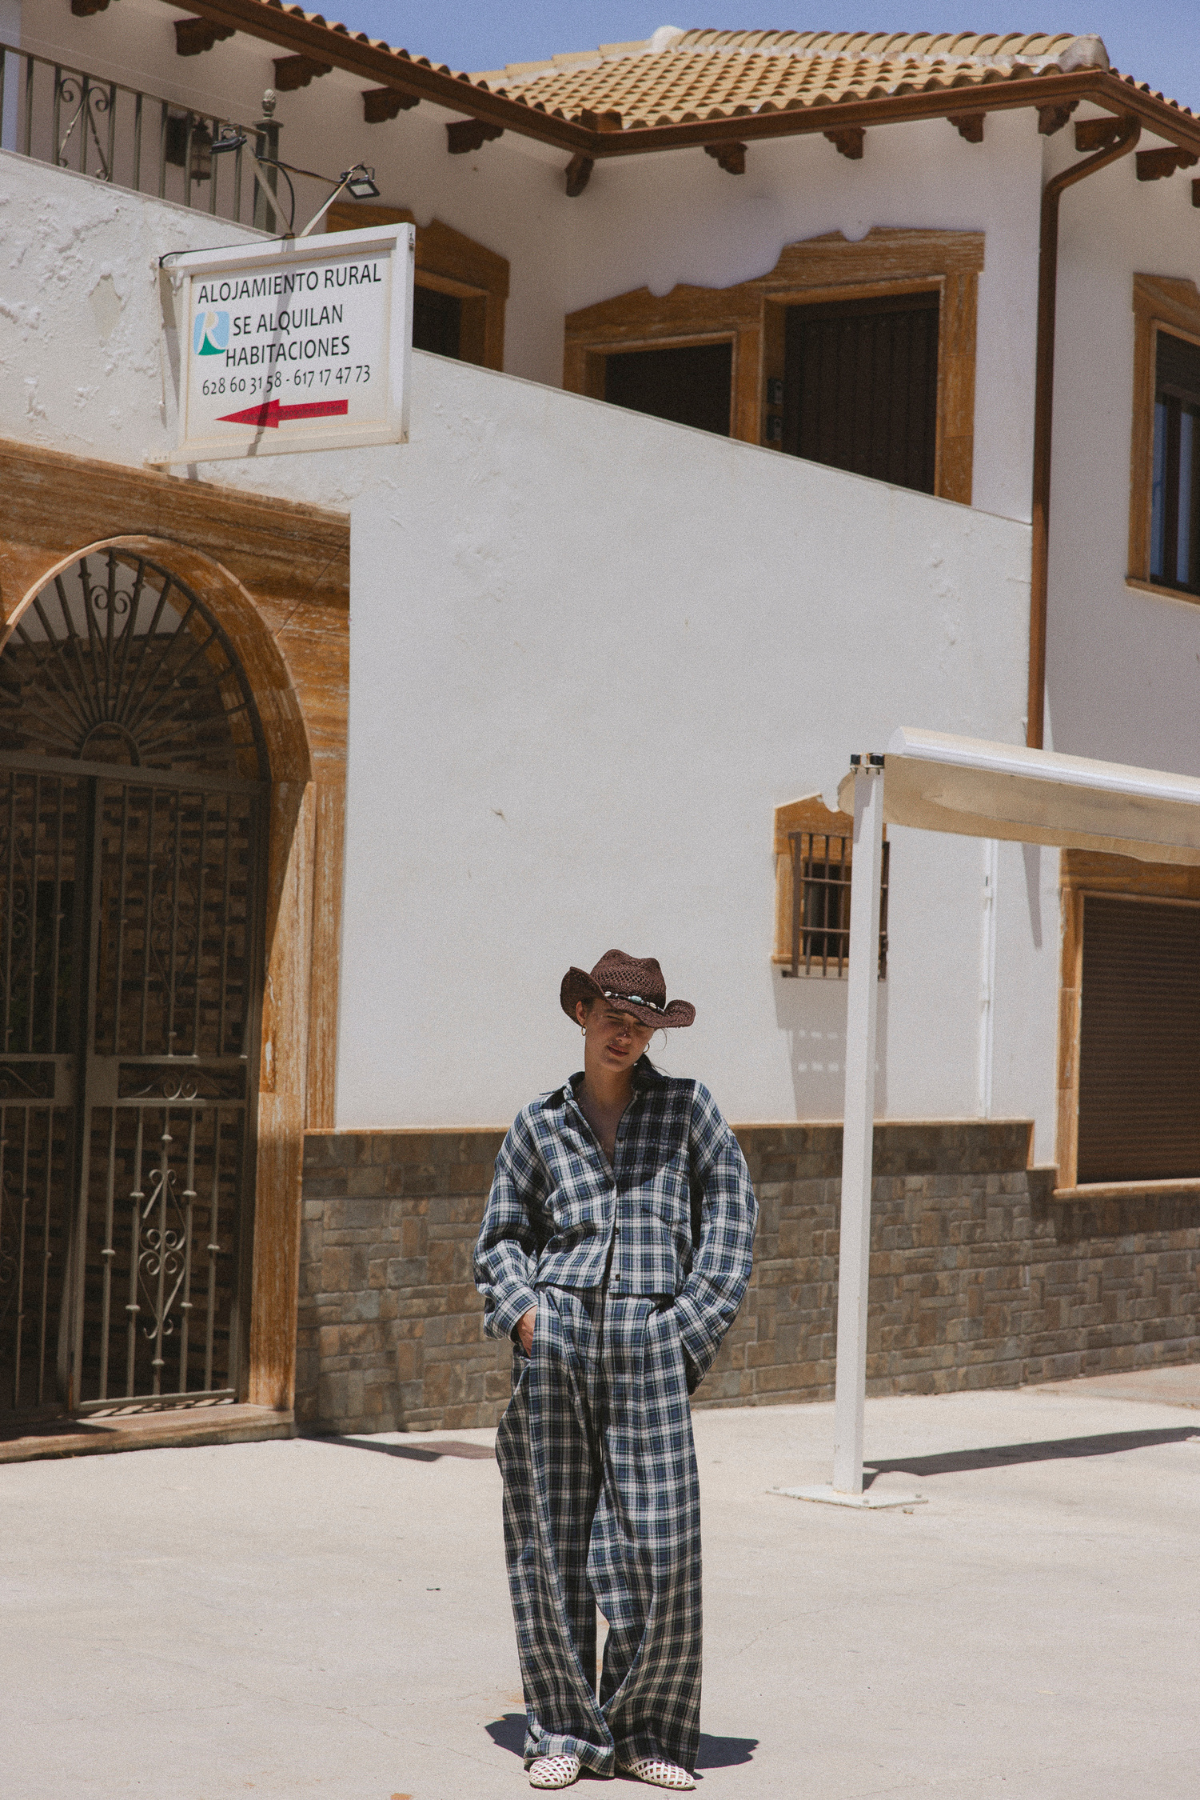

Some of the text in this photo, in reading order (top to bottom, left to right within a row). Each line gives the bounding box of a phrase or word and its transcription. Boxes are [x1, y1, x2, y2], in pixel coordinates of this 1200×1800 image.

[198, 263, 382, 304] ALOJAMIENTO RURAL
[233, 304, 343, 336] SE ALQUILAN
[226, 335, 350, 367] HABITACIONES
[202, 378, 226, 396] 628
[230, 376, 246, 393] 60
[249, 376, 262, 395] 31
[266, 371, 282, 393] 58
[293, 369, 315, 388] 617
[320, 368, 331, 386] 17
[335, 366, 352, 384] 47
[355, 364, 371, 383] 73
